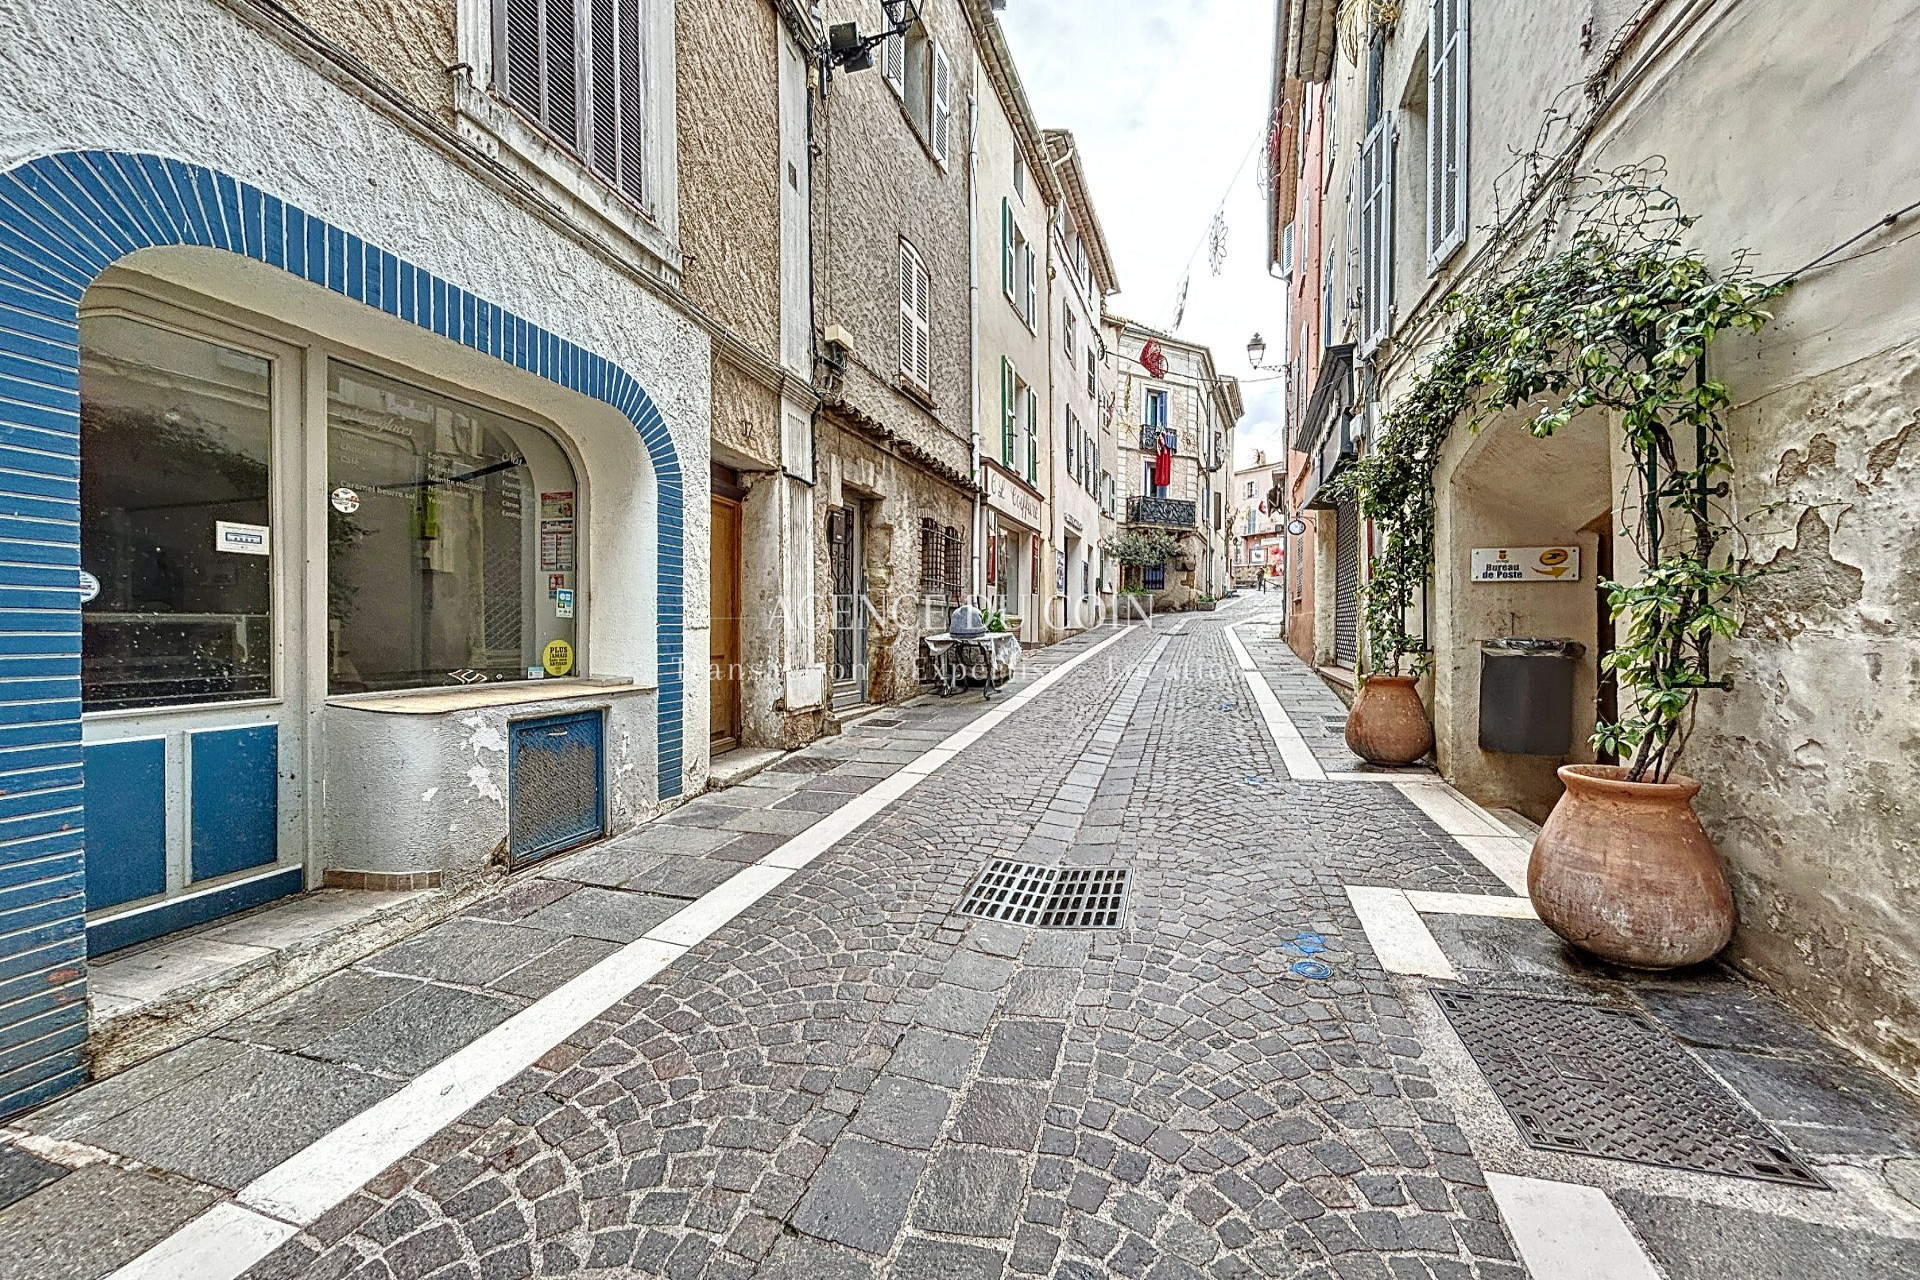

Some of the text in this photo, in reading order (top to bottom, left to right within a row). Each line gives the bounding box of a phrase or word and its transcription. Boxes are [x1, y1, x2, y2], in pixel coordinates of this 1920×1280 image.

[428, 474, 455, 485] Menthe
[340, 480, 376, 494] Caramel
[501, 500, 520, 509] Citron
[1010, 486, 1039, 521] Coiffure
[1486, 563, 1519, 571] Bureau
[549, 646, 568, 654] PLUS
